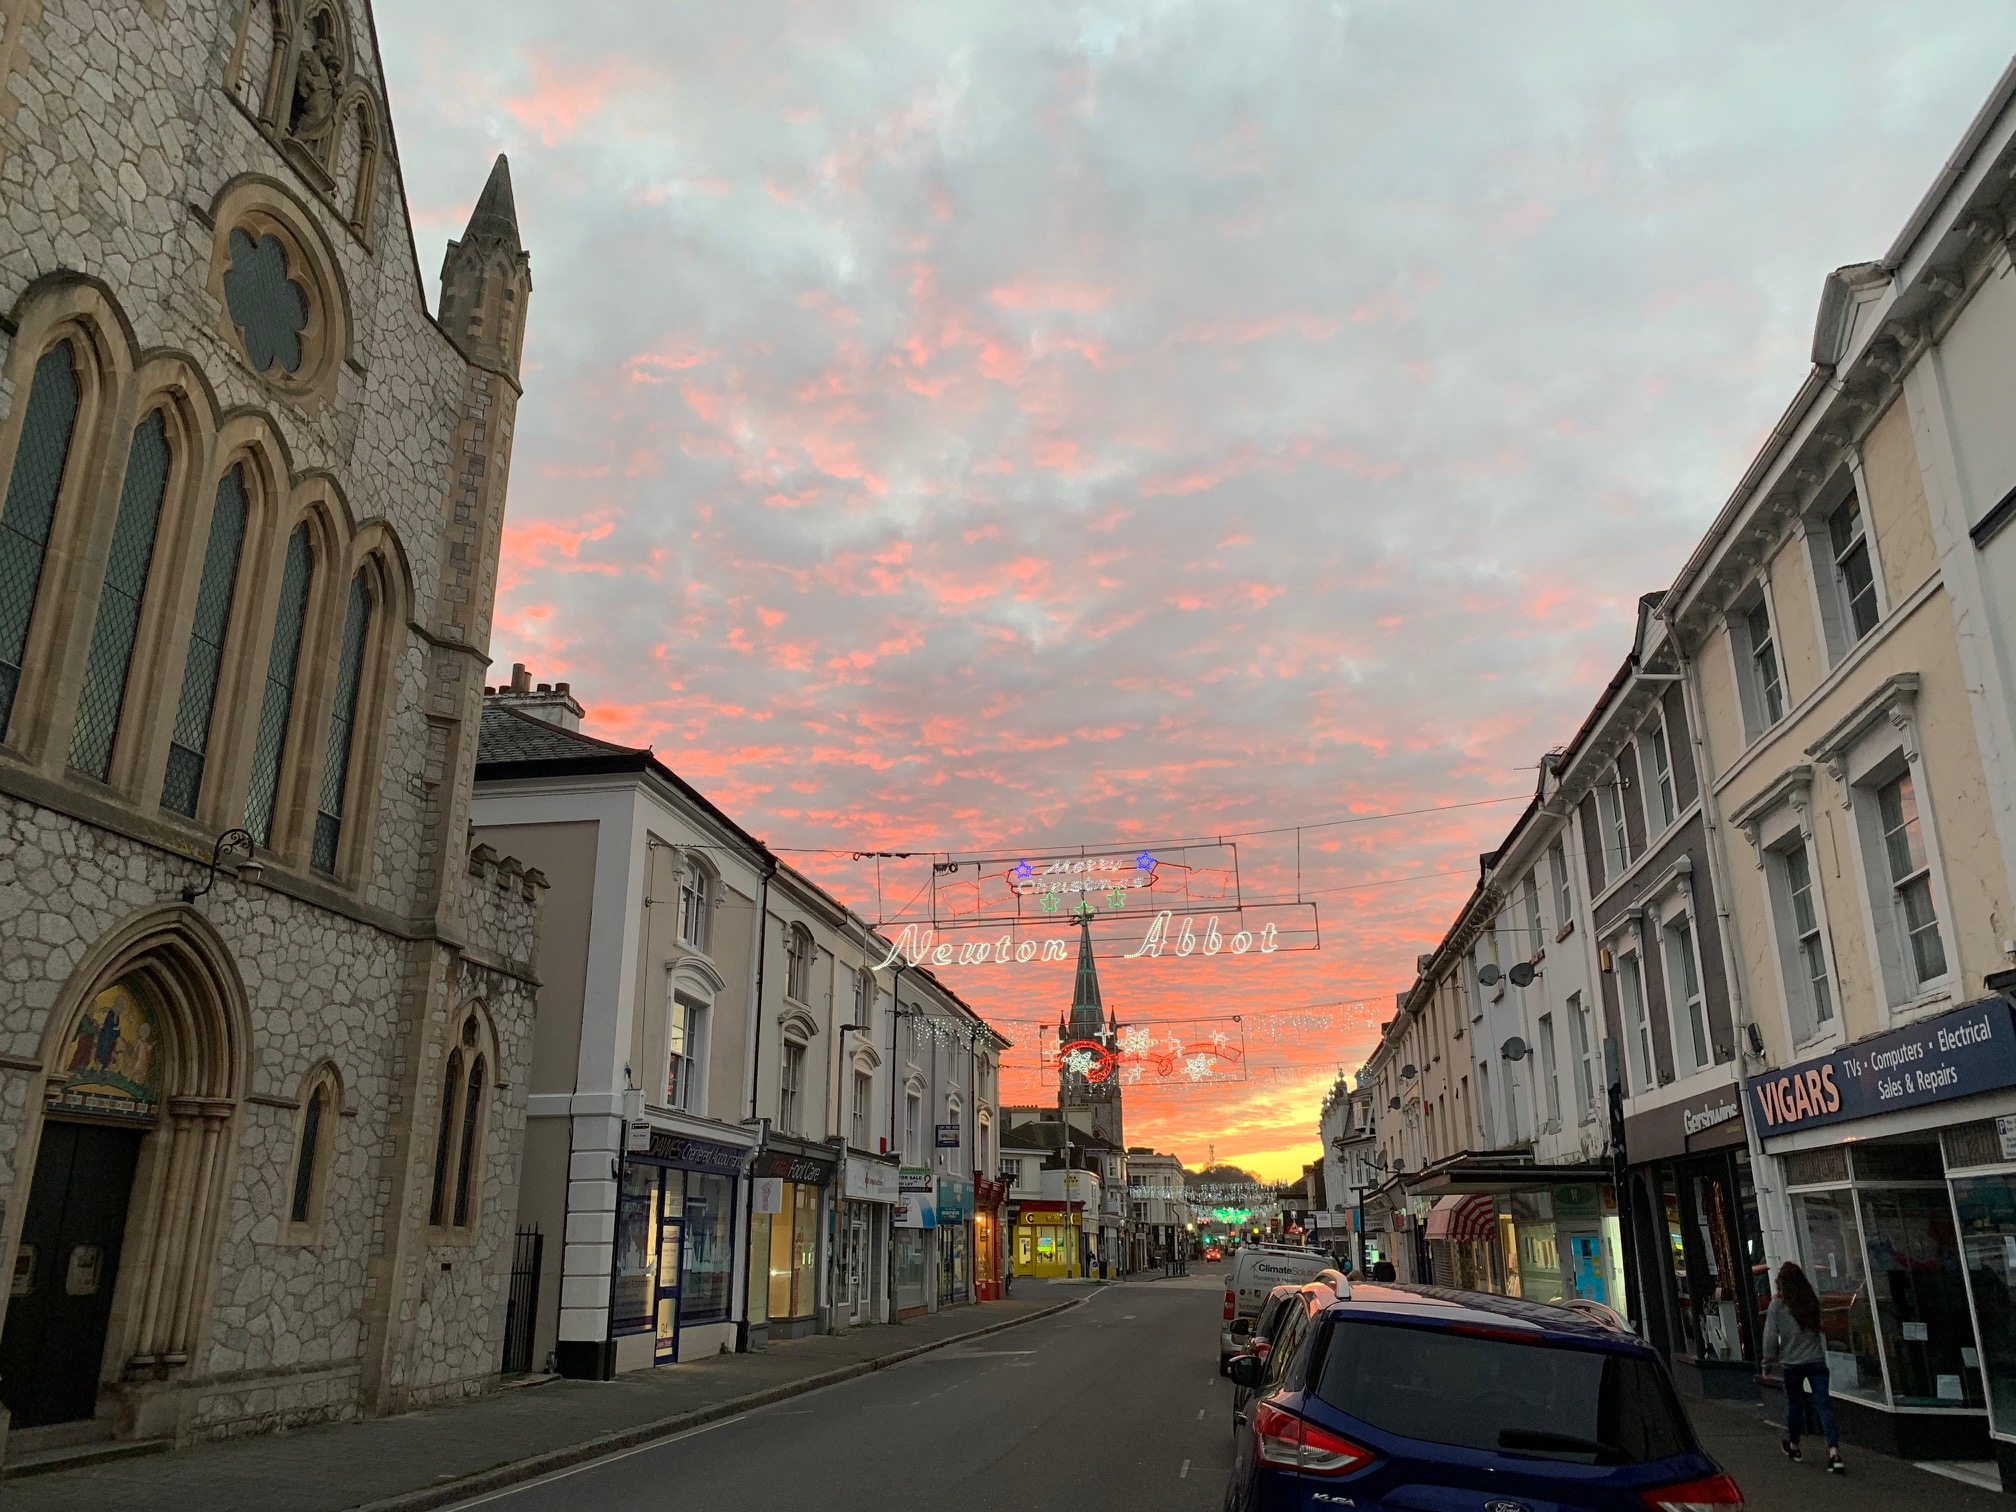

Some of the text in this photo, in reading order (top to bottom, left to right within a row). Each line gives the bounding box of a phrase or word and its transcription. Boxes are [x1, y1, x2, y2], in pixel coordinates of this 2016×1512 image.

[1042, 858, 1123, 875] Merry
[1016, 875, 1144, 895] Christmas
[871, 910, 1279, 971] Newton Abbot
[1844, 1014, 1992, 1080] TVs Computers Electrical
[1878, 1063, 1959, 1101] Sales & Repairs
[1756, 1063, 1841, 1126] VIGARS
[682, 1143, 713, 1163] Chartered
[787, 1159, 807, 1179] Foot
[804, 1162, 821, 1181] Care
[1254, 1275, 1276, 1283] Plumbing
[1311, 1492, 1356, 1508] KUGA
